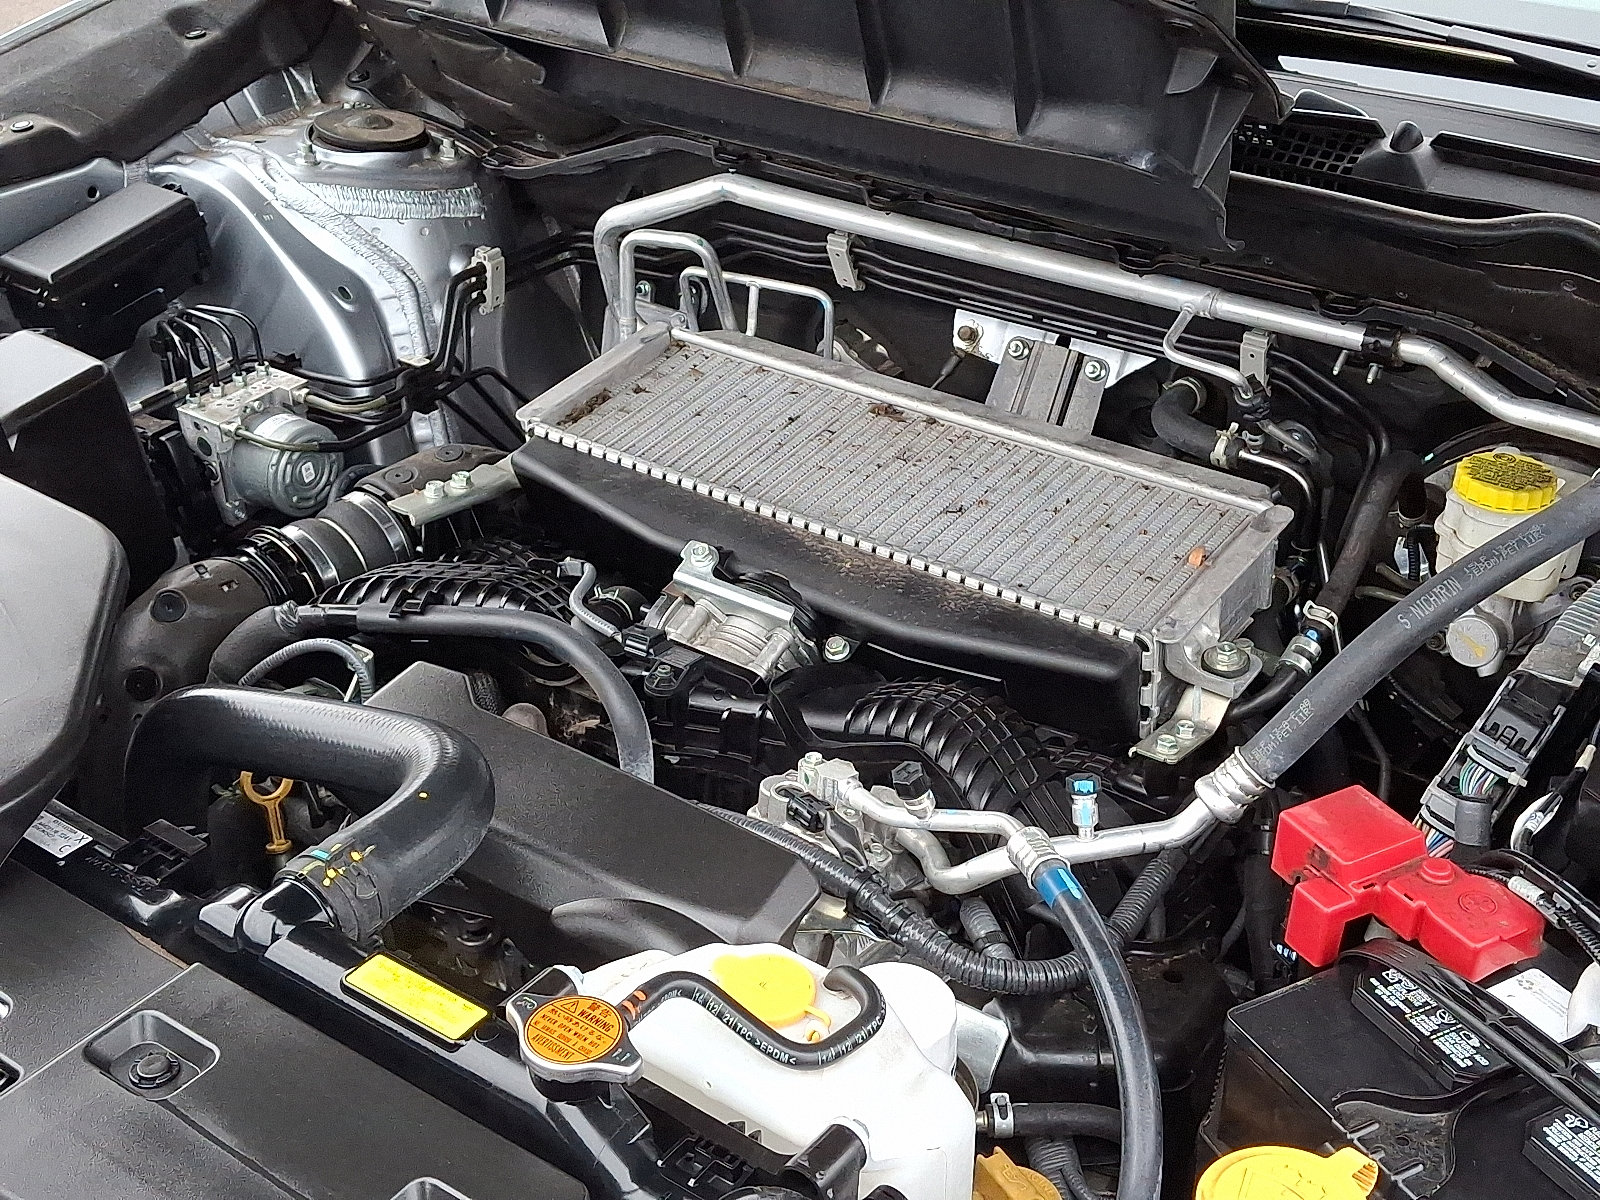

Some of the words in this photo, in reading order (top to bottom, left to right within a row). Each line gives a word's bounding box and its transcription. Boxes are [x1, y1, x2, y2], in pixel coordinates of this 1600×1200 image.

[558, 1022, 573, 1033] OPEN
[577, 1008, 615, 1032] WARNING
[736, 1023, 753, 1041] TPC
